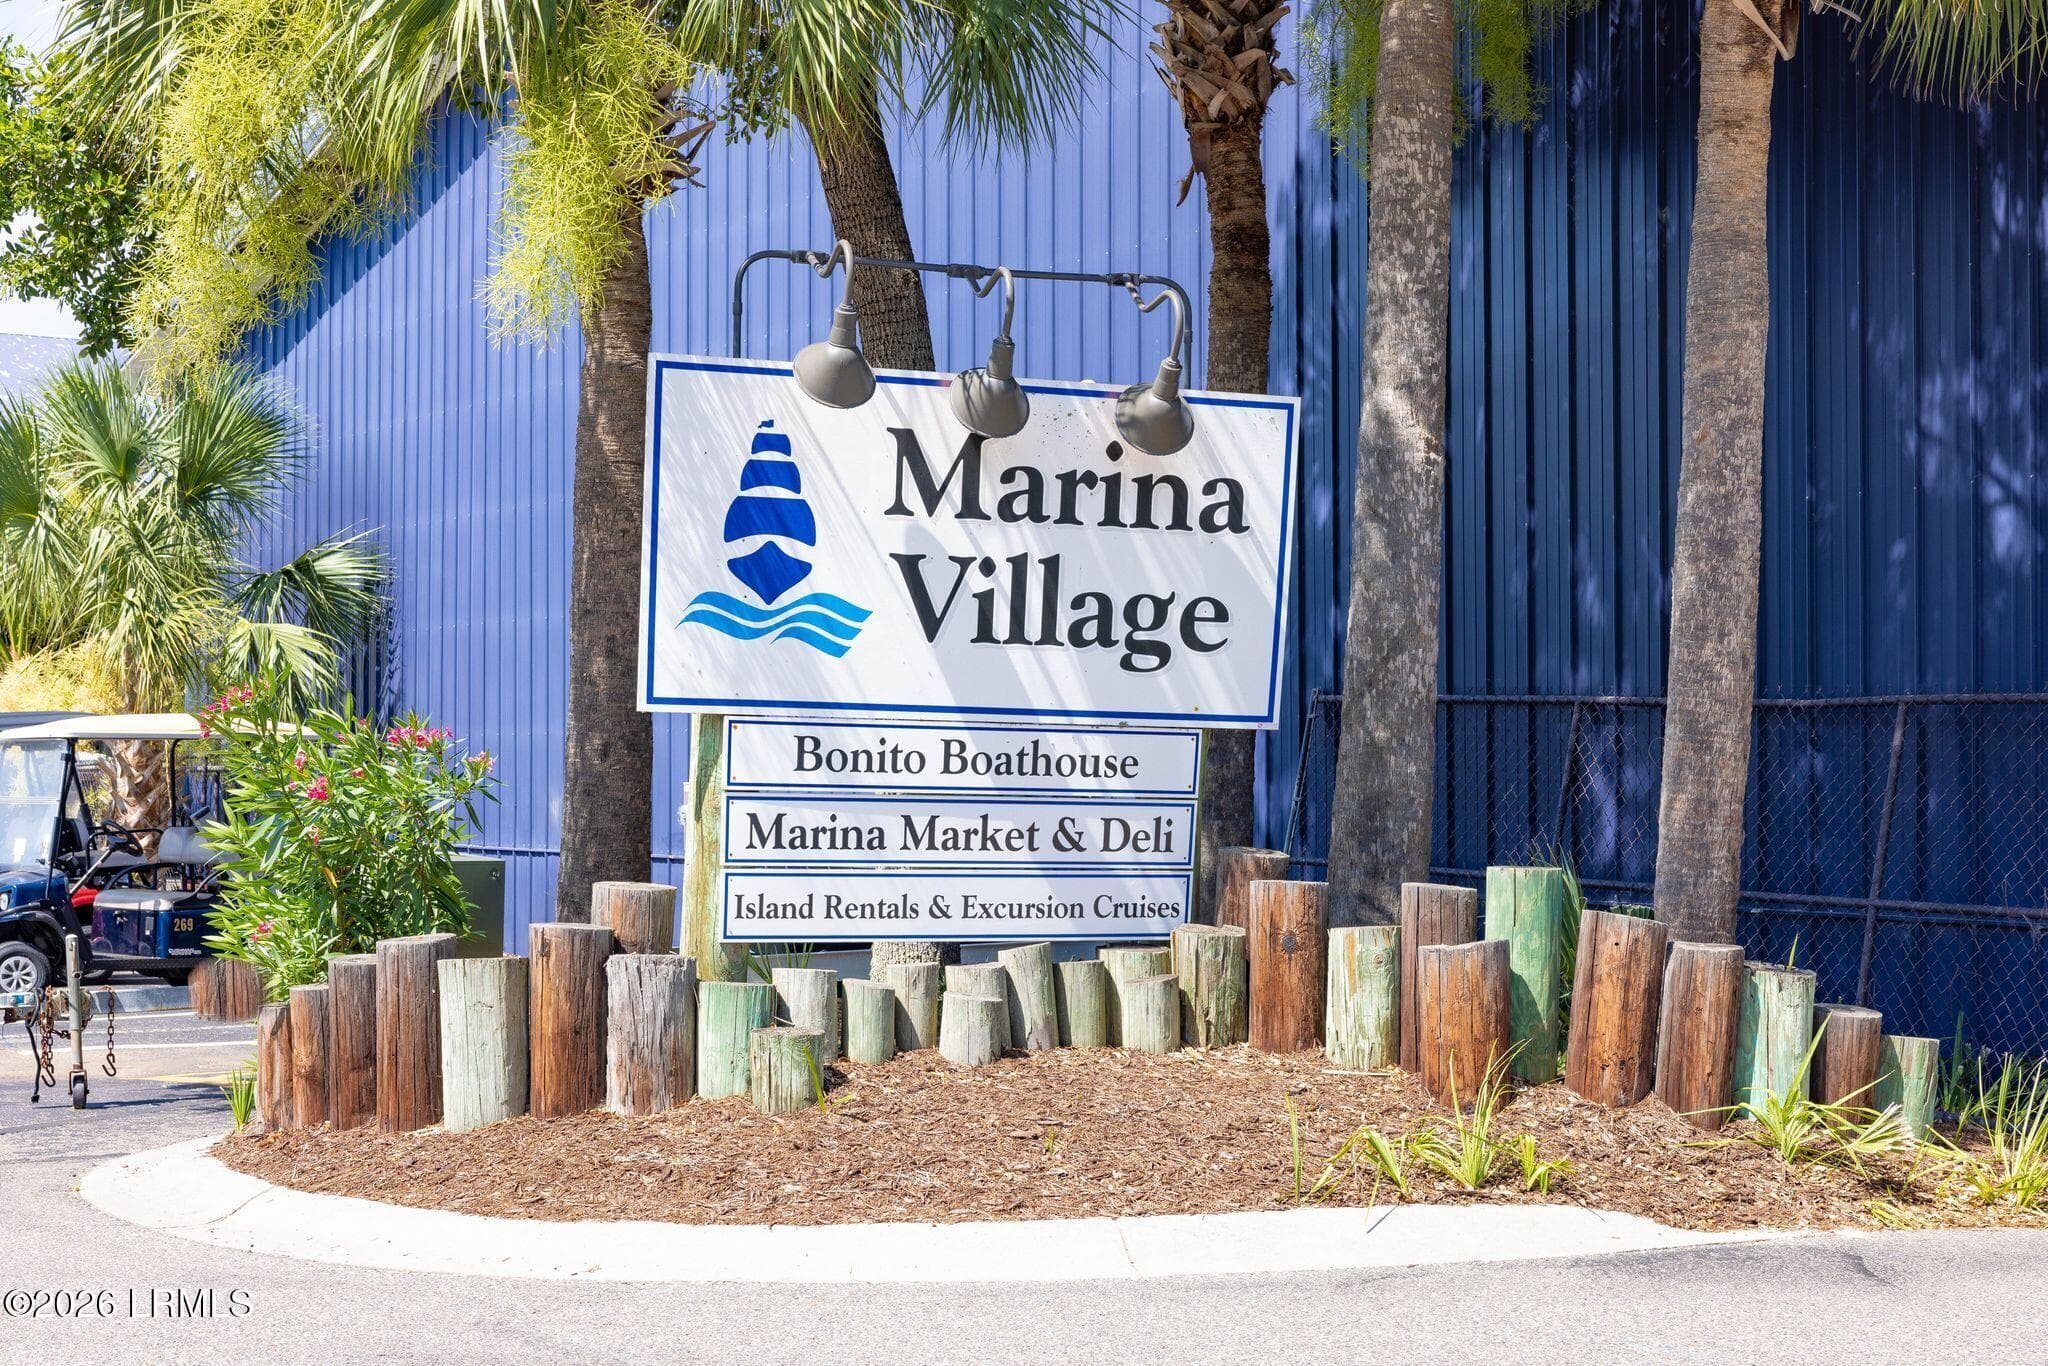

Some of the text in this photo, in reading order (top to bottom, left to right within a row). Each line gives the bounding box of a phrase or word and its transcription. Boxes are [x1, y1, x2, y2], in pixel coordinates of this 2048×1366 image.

[884, 427, 1251, 534] Marina
[889, 552, 1230, 673] Village
[794, 735, 1139, 779] Bonito Boathouse
[746, 812, 1174, 853] Marina Market & Deli
[173, 917, 194, 932] 269
[734, 893, 1180, 920] Island Rentals & Excursion Cruises
